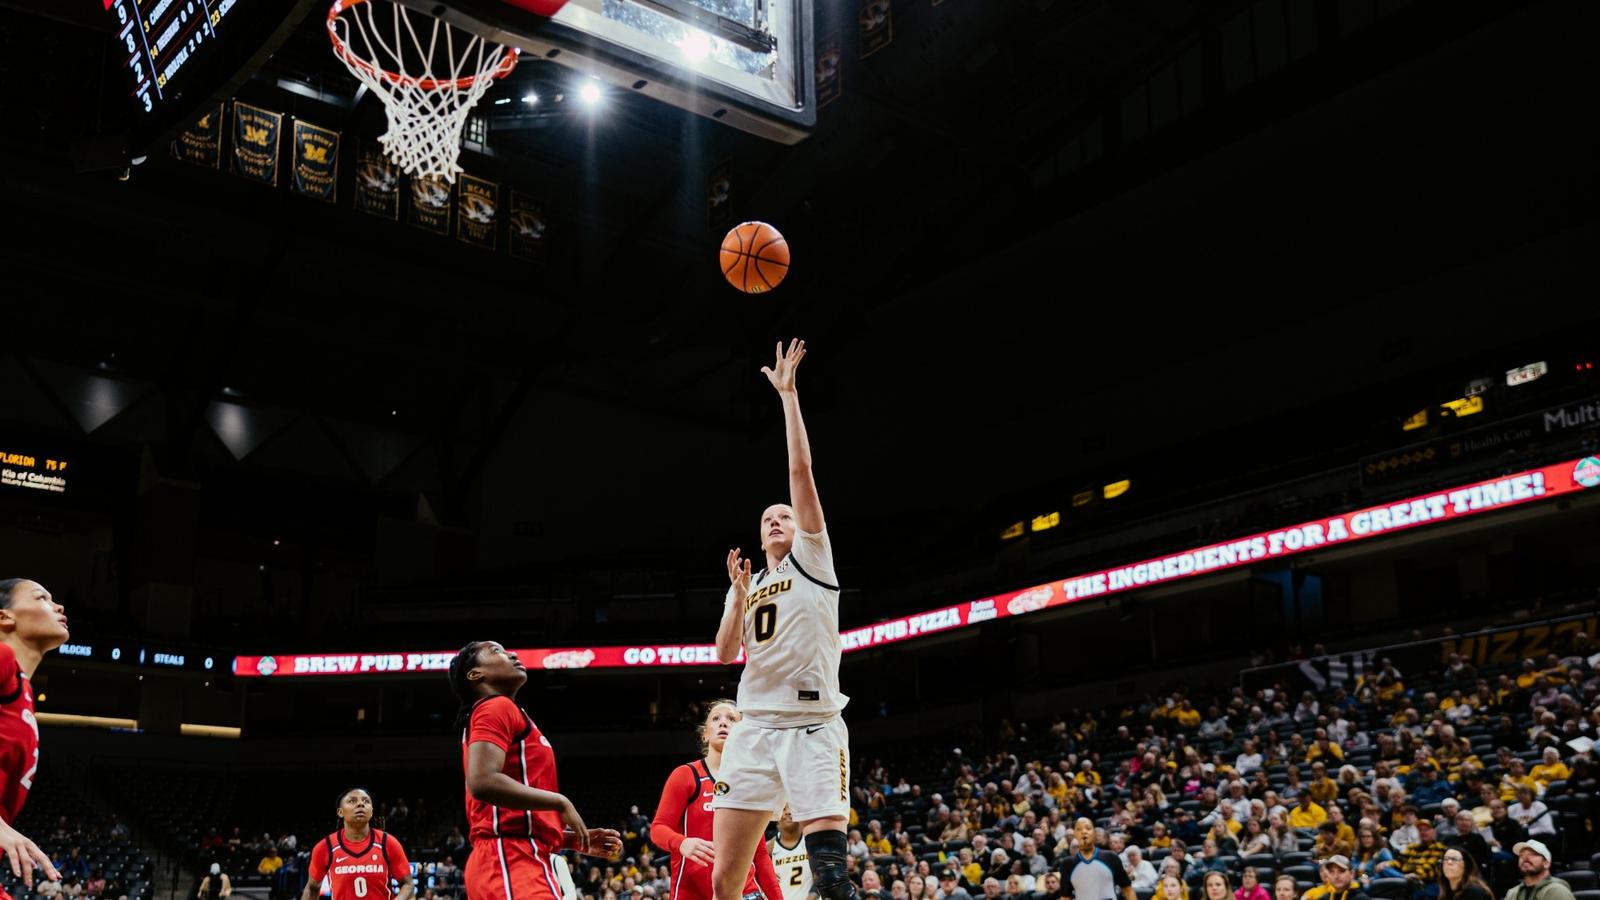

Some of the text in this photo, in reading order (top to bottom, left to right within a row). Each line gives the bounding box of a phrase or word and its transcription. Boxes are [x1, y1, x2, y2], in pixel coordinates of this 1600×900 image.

[118, 4, 127, 25] 9
[211, 9, 221, 28] 23
[126, 33, 136, 54] 8
[189, 39, 196, 53] 2
[195, 31, 202, 44] 0
[203, 22, 210, 36] 2
[134, 62, 144, 84] 2
[142, 91, 153, 112] 3
[303, 142, 329, 164] M
[1063, 573, 1107, 600] THE
[1108, 537, 1266, 591] INGREDIENTS
[1268, 523, 1325, 555] FOR
[1327, 517, 1348, 542] A
[1350, 493, 1448, 536] GREAT
[1448, 471, 1546, 514] TIME!
[745, 578, 793, 614] IZZOU
[754, 602, 778, 644] 0
[840, 628, 872, 650] REW
[873, 620, 908, 643] PUB
[908, 608, 961, 635] PIZZA
[59, 643, 121, 660] BLOCKS 0
[153, 652, 214, 669] STEALS 0
[624, 648, 656, 664] GO
[294, 656, 358, 673] BREW
[360, 654, 404, 671] PUB
[407, 653, 457, 670] PIZZ
[334, 864, 384, 875] GEORGIA
[790, 865, 803, 886] 2
[353, 876, 368, 898] 0
